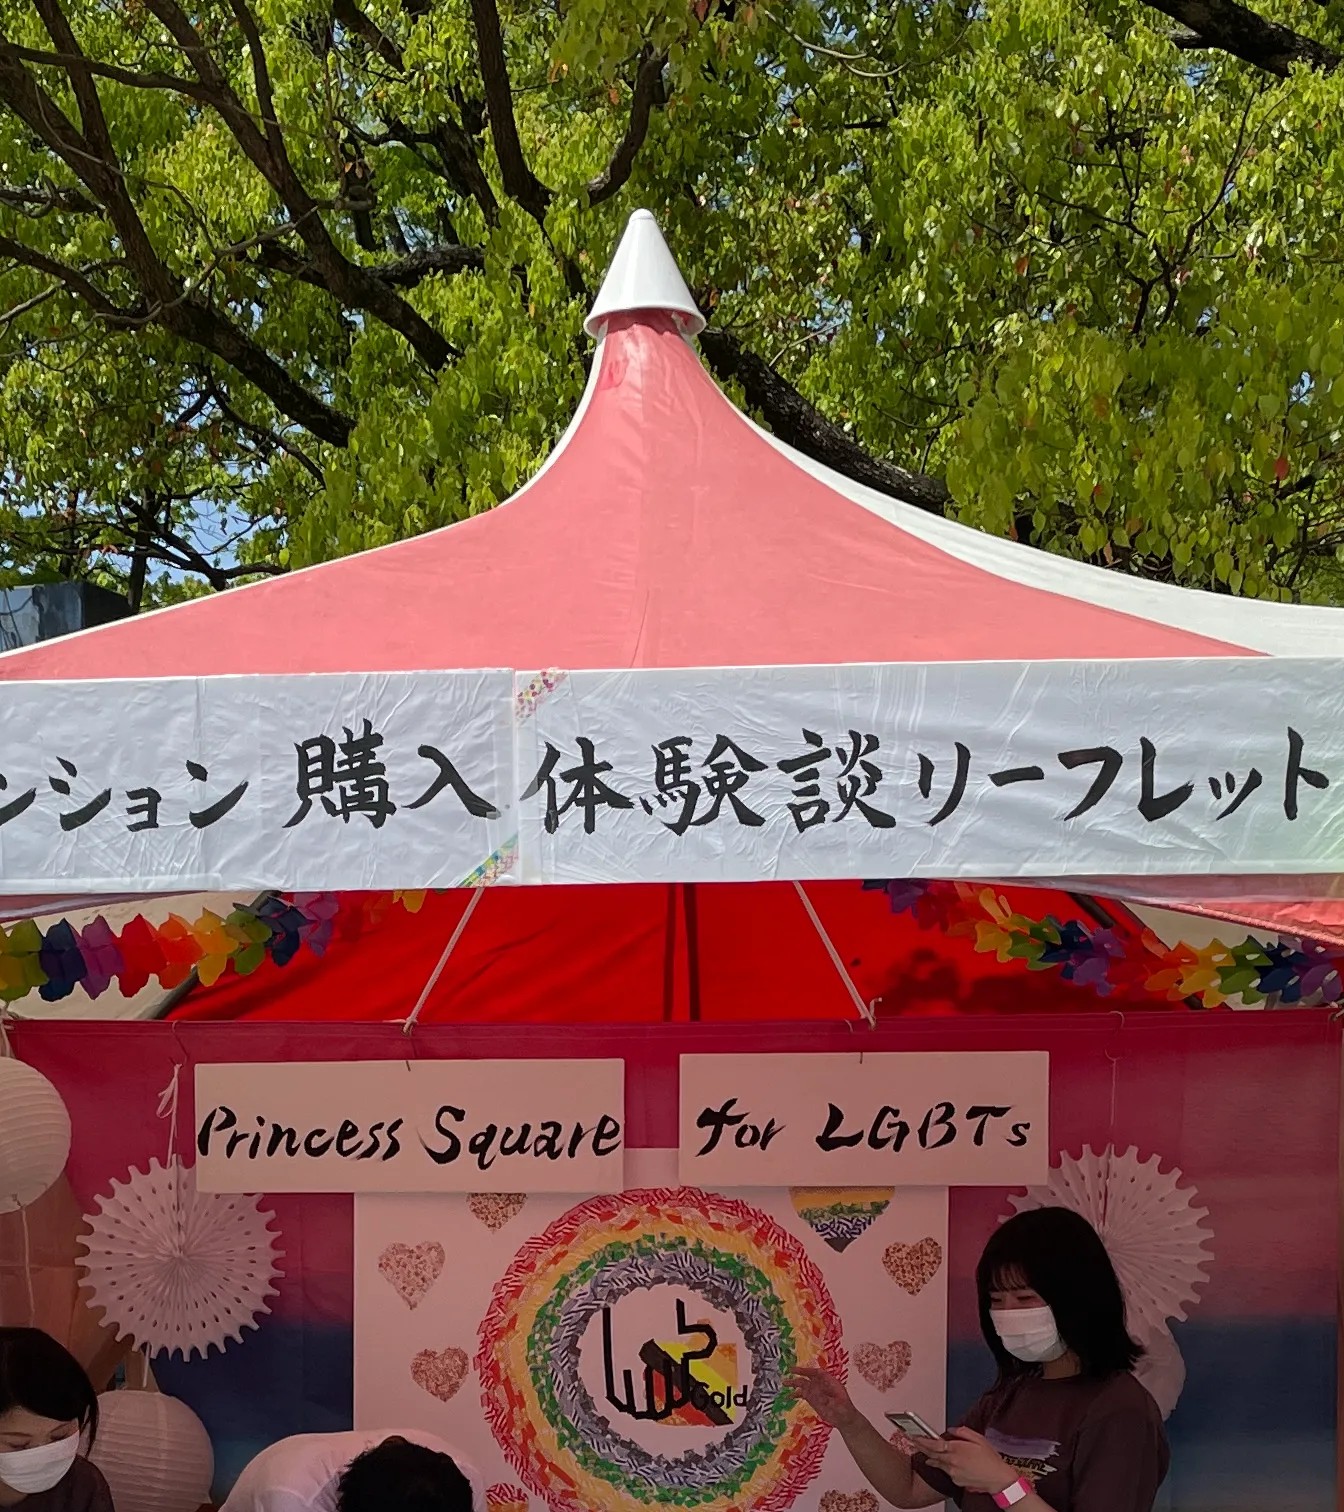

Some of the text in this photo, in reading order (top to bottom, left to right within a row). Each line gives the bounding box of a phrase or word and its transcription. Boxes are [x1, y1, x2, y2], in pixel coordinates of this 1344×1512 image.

[198, 1105, 624, 1170] Princess Square
[695, 1097, 1032, 1157] for LGBTs
